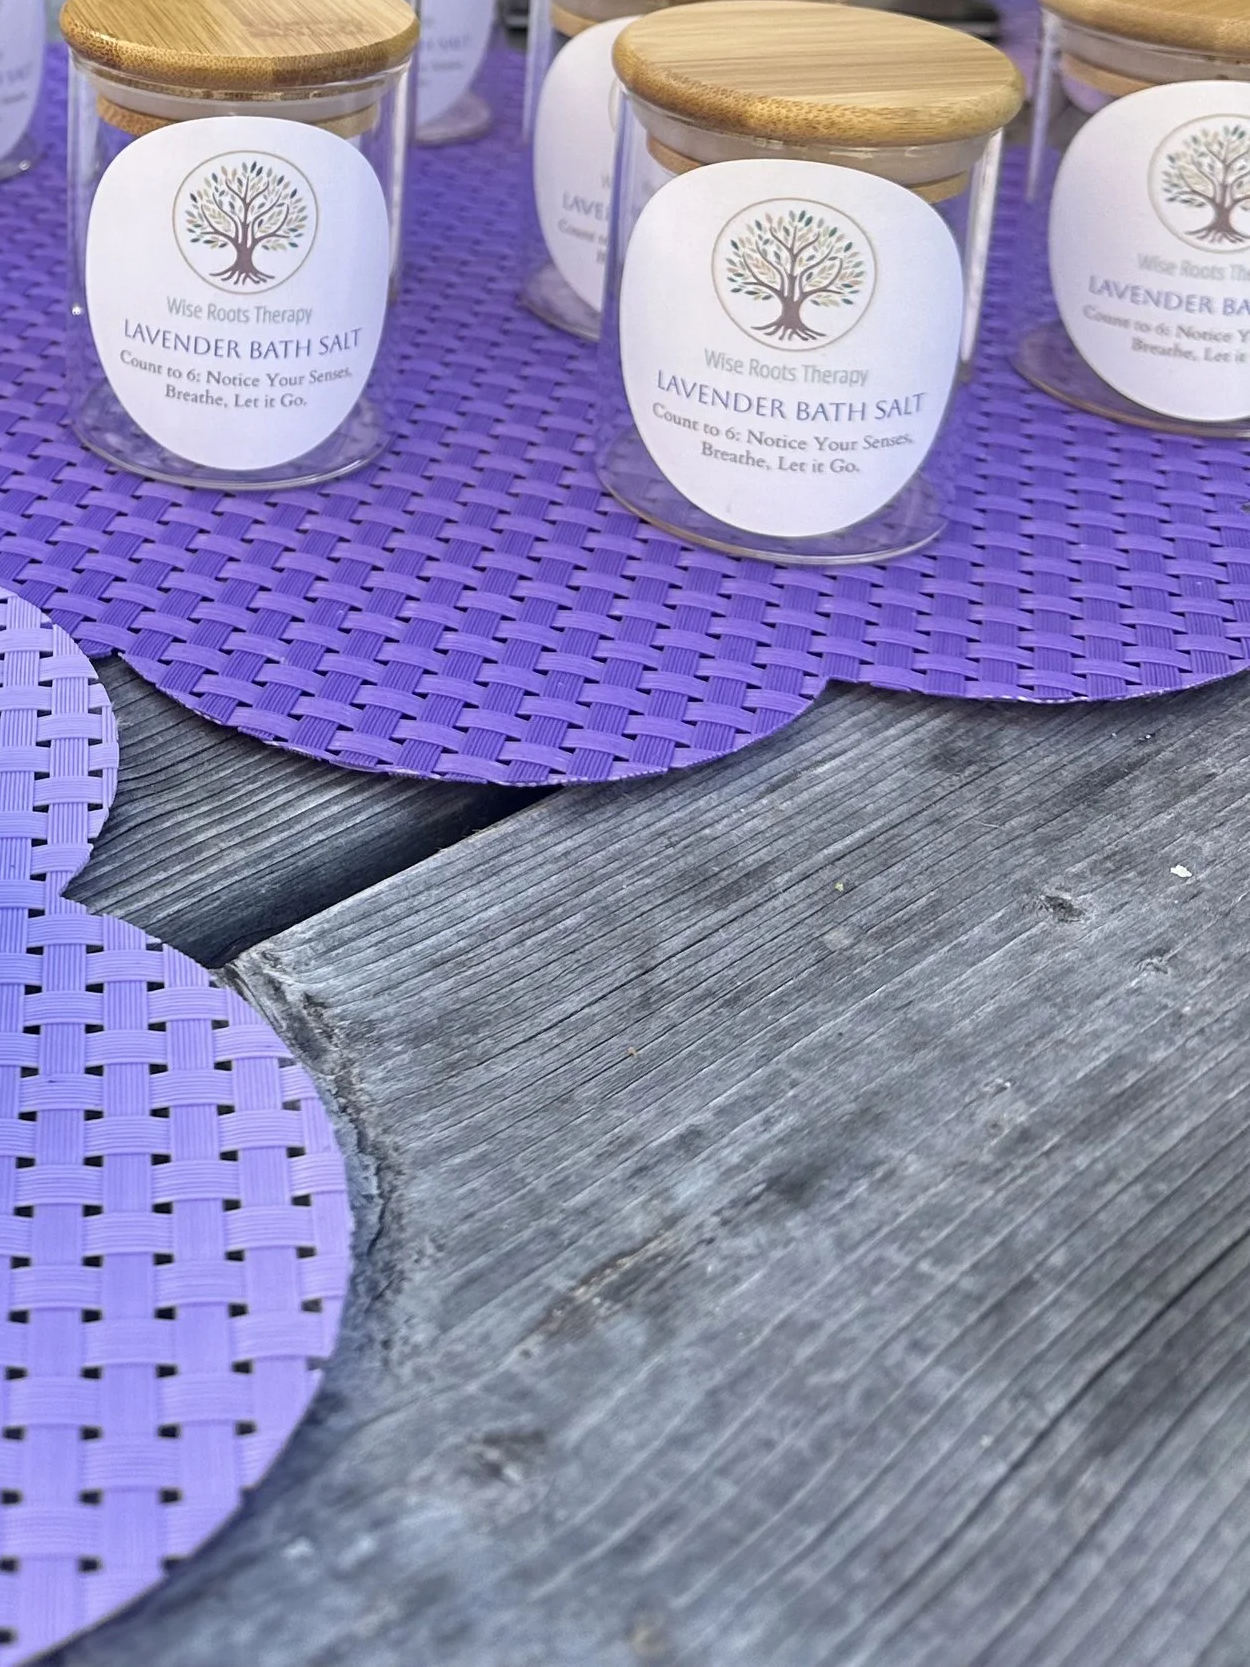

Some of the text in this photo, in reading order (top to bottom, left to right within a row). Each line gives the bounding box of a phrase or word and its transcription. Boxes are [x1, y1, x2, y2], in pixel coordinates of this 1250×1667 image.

[1137, 253, 1177, 276] Wise
[1179, 259, 1225, 280] Roots
[167, 296, 313, 327] Wise Roots Therapy
[1088, 274, 1214, 314] LAVENDER
[123, 318, 362, 360] LAVENDER BATH SALT
[1082, 304, 1130, 329] Count
[1175, 325, 1232, 343] Notice
[119, 349, 163, 375] Count
[166, 365, 182, 380] to
[186, 368, 201, 383] 6:
[206, 369, 260, 387] Notice
[266, 372, 304, 387] Your
[704, 347, 869, 387] Wise Roots Therapy
[1204, 347, 1231, 362] Let
[165, 383, 307, 408] Breathe, Let it Go.
[657, 369, 928, 422] LAVENDER BATH SALT
[651, 401, 699, 431] Count
[703, 421, 720, 437] to
[725, 426, 741, 441] 6:
[746, 429, 808, 451] Notice
[814, 436, 859, 452] Your
[701, 440, 861, 474] Breathe, Let it Go.
